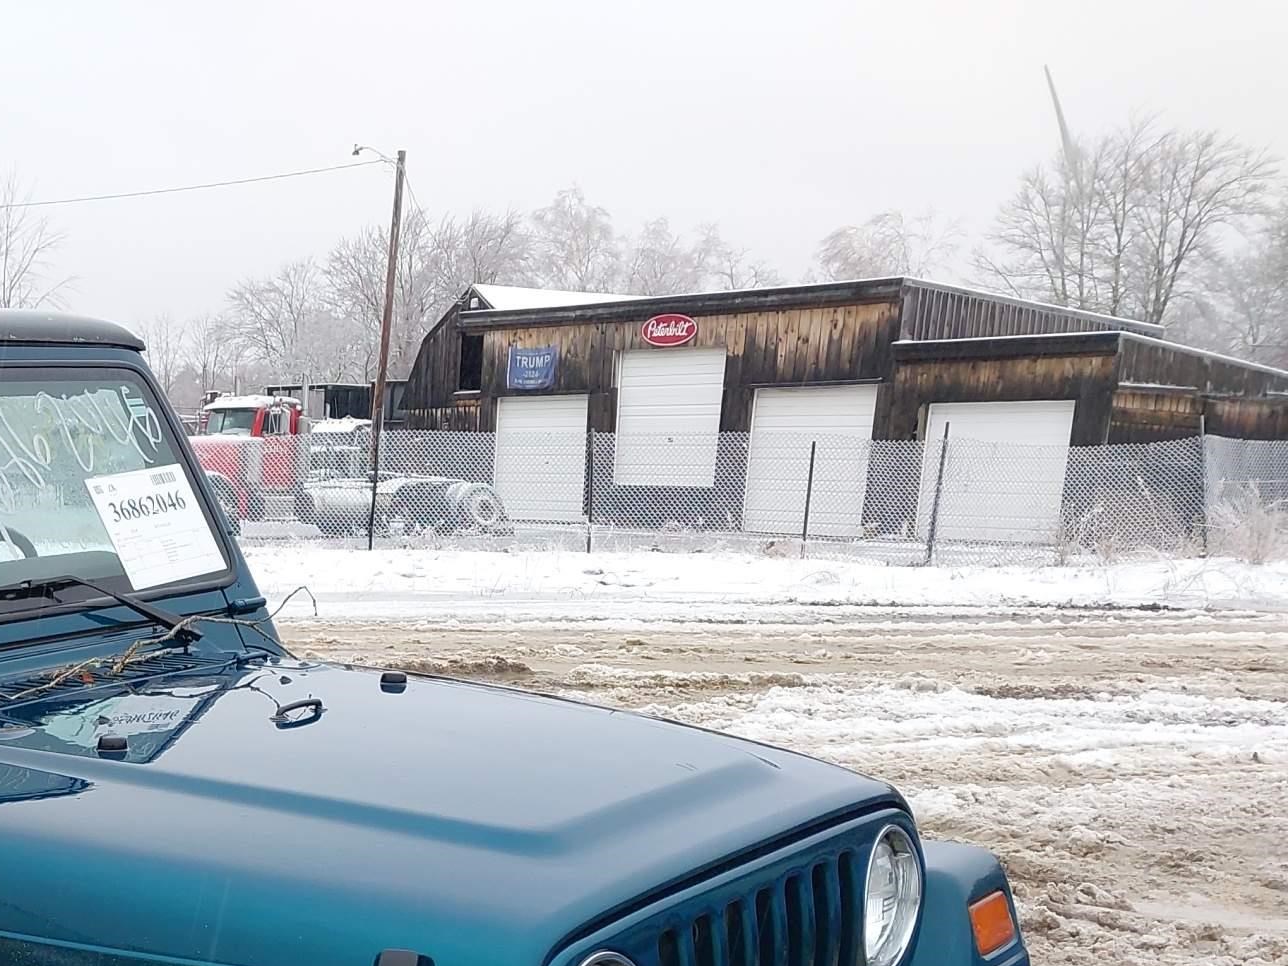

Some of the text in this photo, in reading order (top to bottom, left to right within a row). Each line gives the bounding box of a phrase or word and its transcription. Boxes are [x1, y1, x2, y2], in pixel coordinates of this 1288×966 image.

[647, 319, 693, 339] Peterbilt
[516, 354, 551, 369] TRUMP
[108, 490, 187, 523] 36862046
